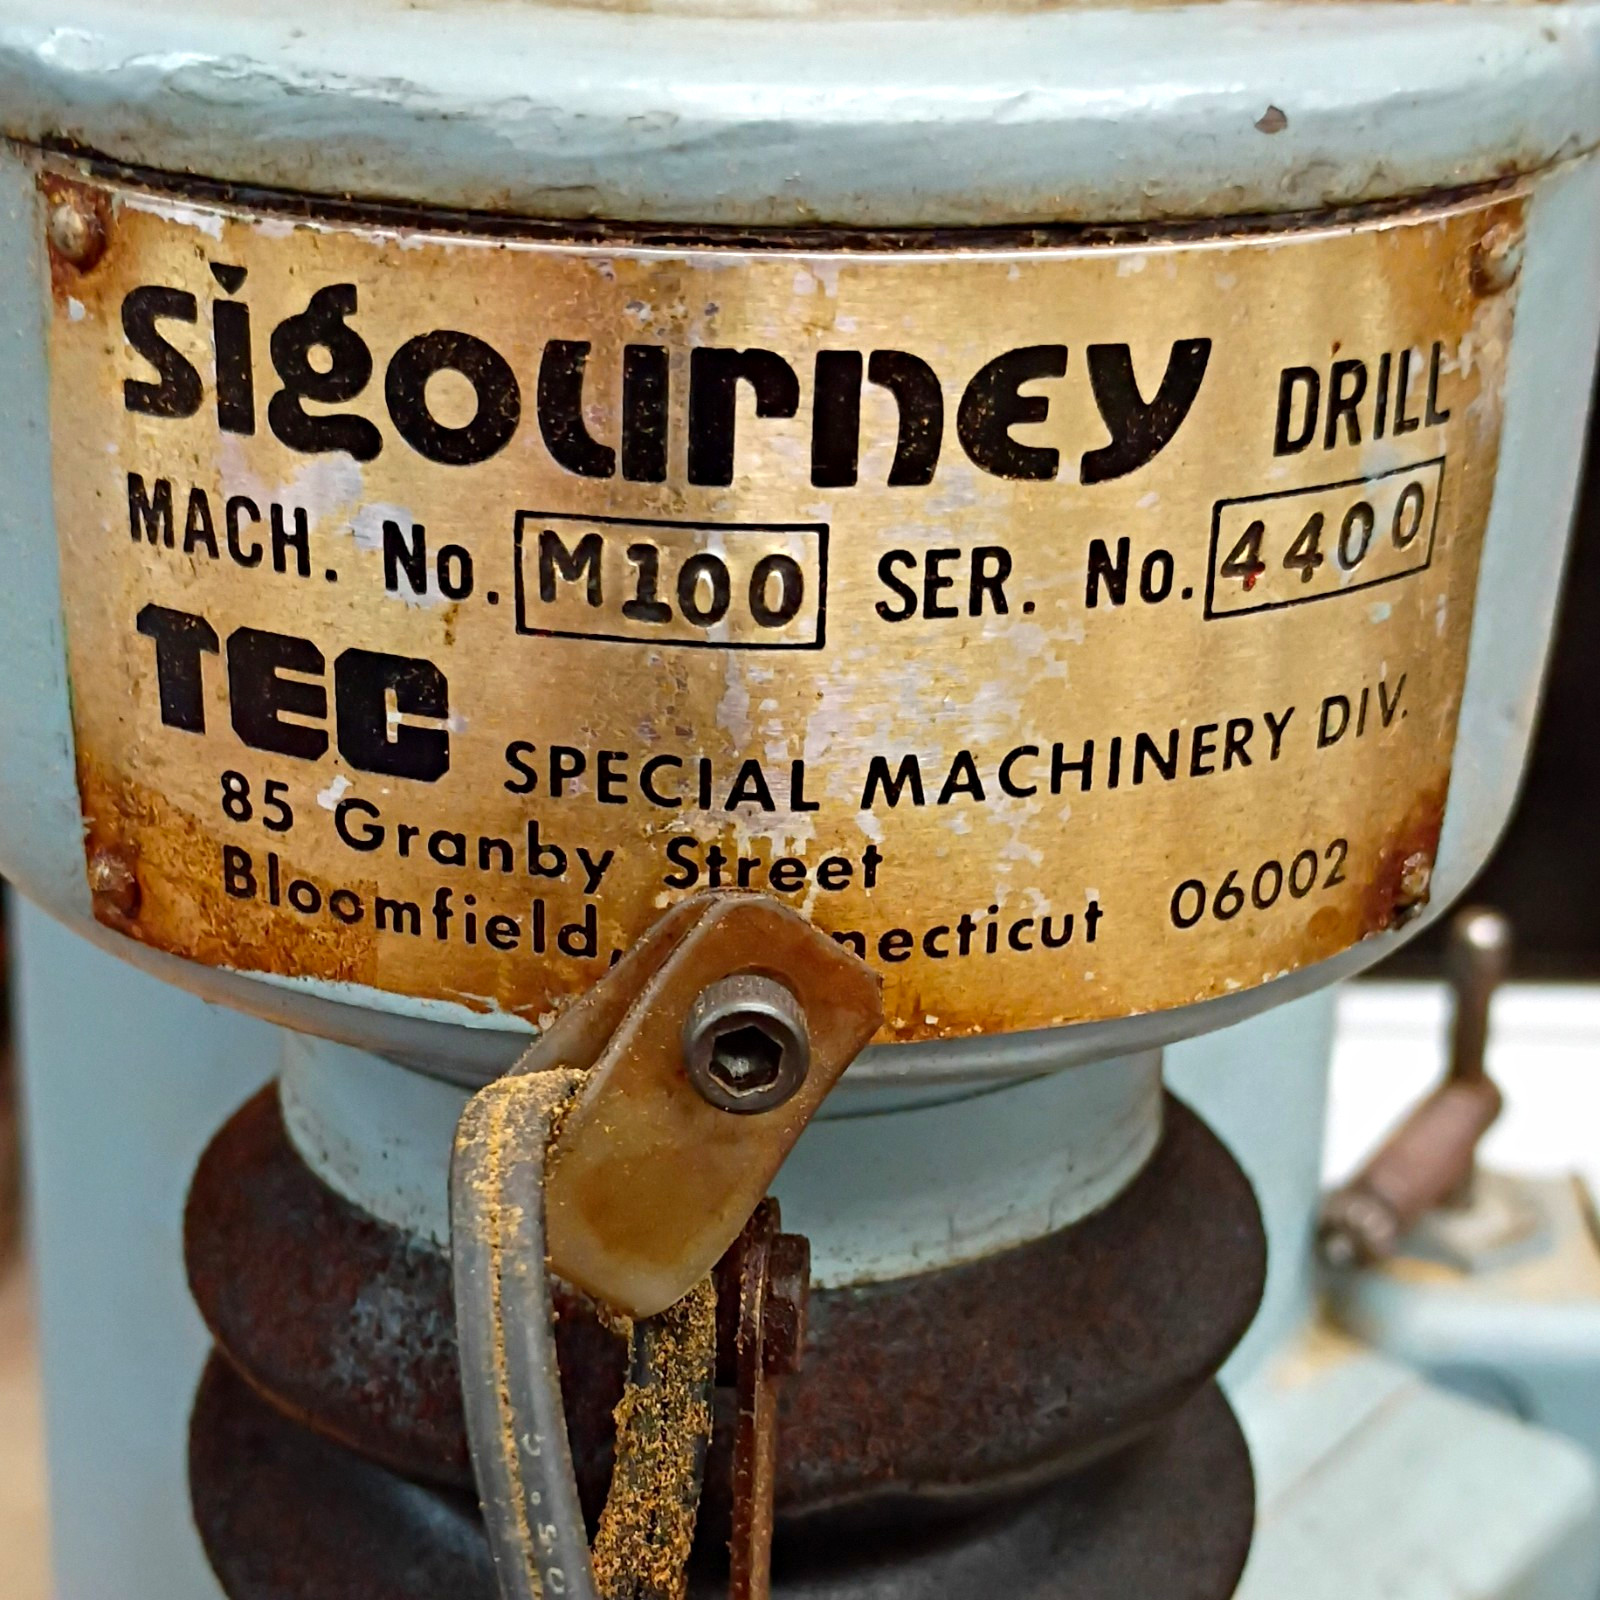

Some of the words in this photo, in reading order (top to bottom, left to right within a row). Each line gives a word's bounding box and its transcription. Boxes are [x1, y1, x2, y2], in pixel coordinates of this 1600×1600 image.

[1274, 342, 1450, 457] DRILL
[128, 472, 337, 581] MACH.
[383, 521, 498, 604] No.
[540, 529, 804, 628] M100
[876, 547, 1035, 622] SER.
[1086, 537, 1192, 608] No.
[1219, 480, 1425, 590] 4400
[137, 602, 450, 783] TEC
[504, 741, 819, 811] SPECIAL
[861, 707, 1295, 809] MACHINERY
[1318, 674, 1407, 748] DIV.
[221, 770, 293, 831] 85
[334, 797, 615, 896] Granby
[663, 836, 882, 892] Street
[830, 901, 1103, 961] necticut
[1171, 839, 1347, 930] 06002
